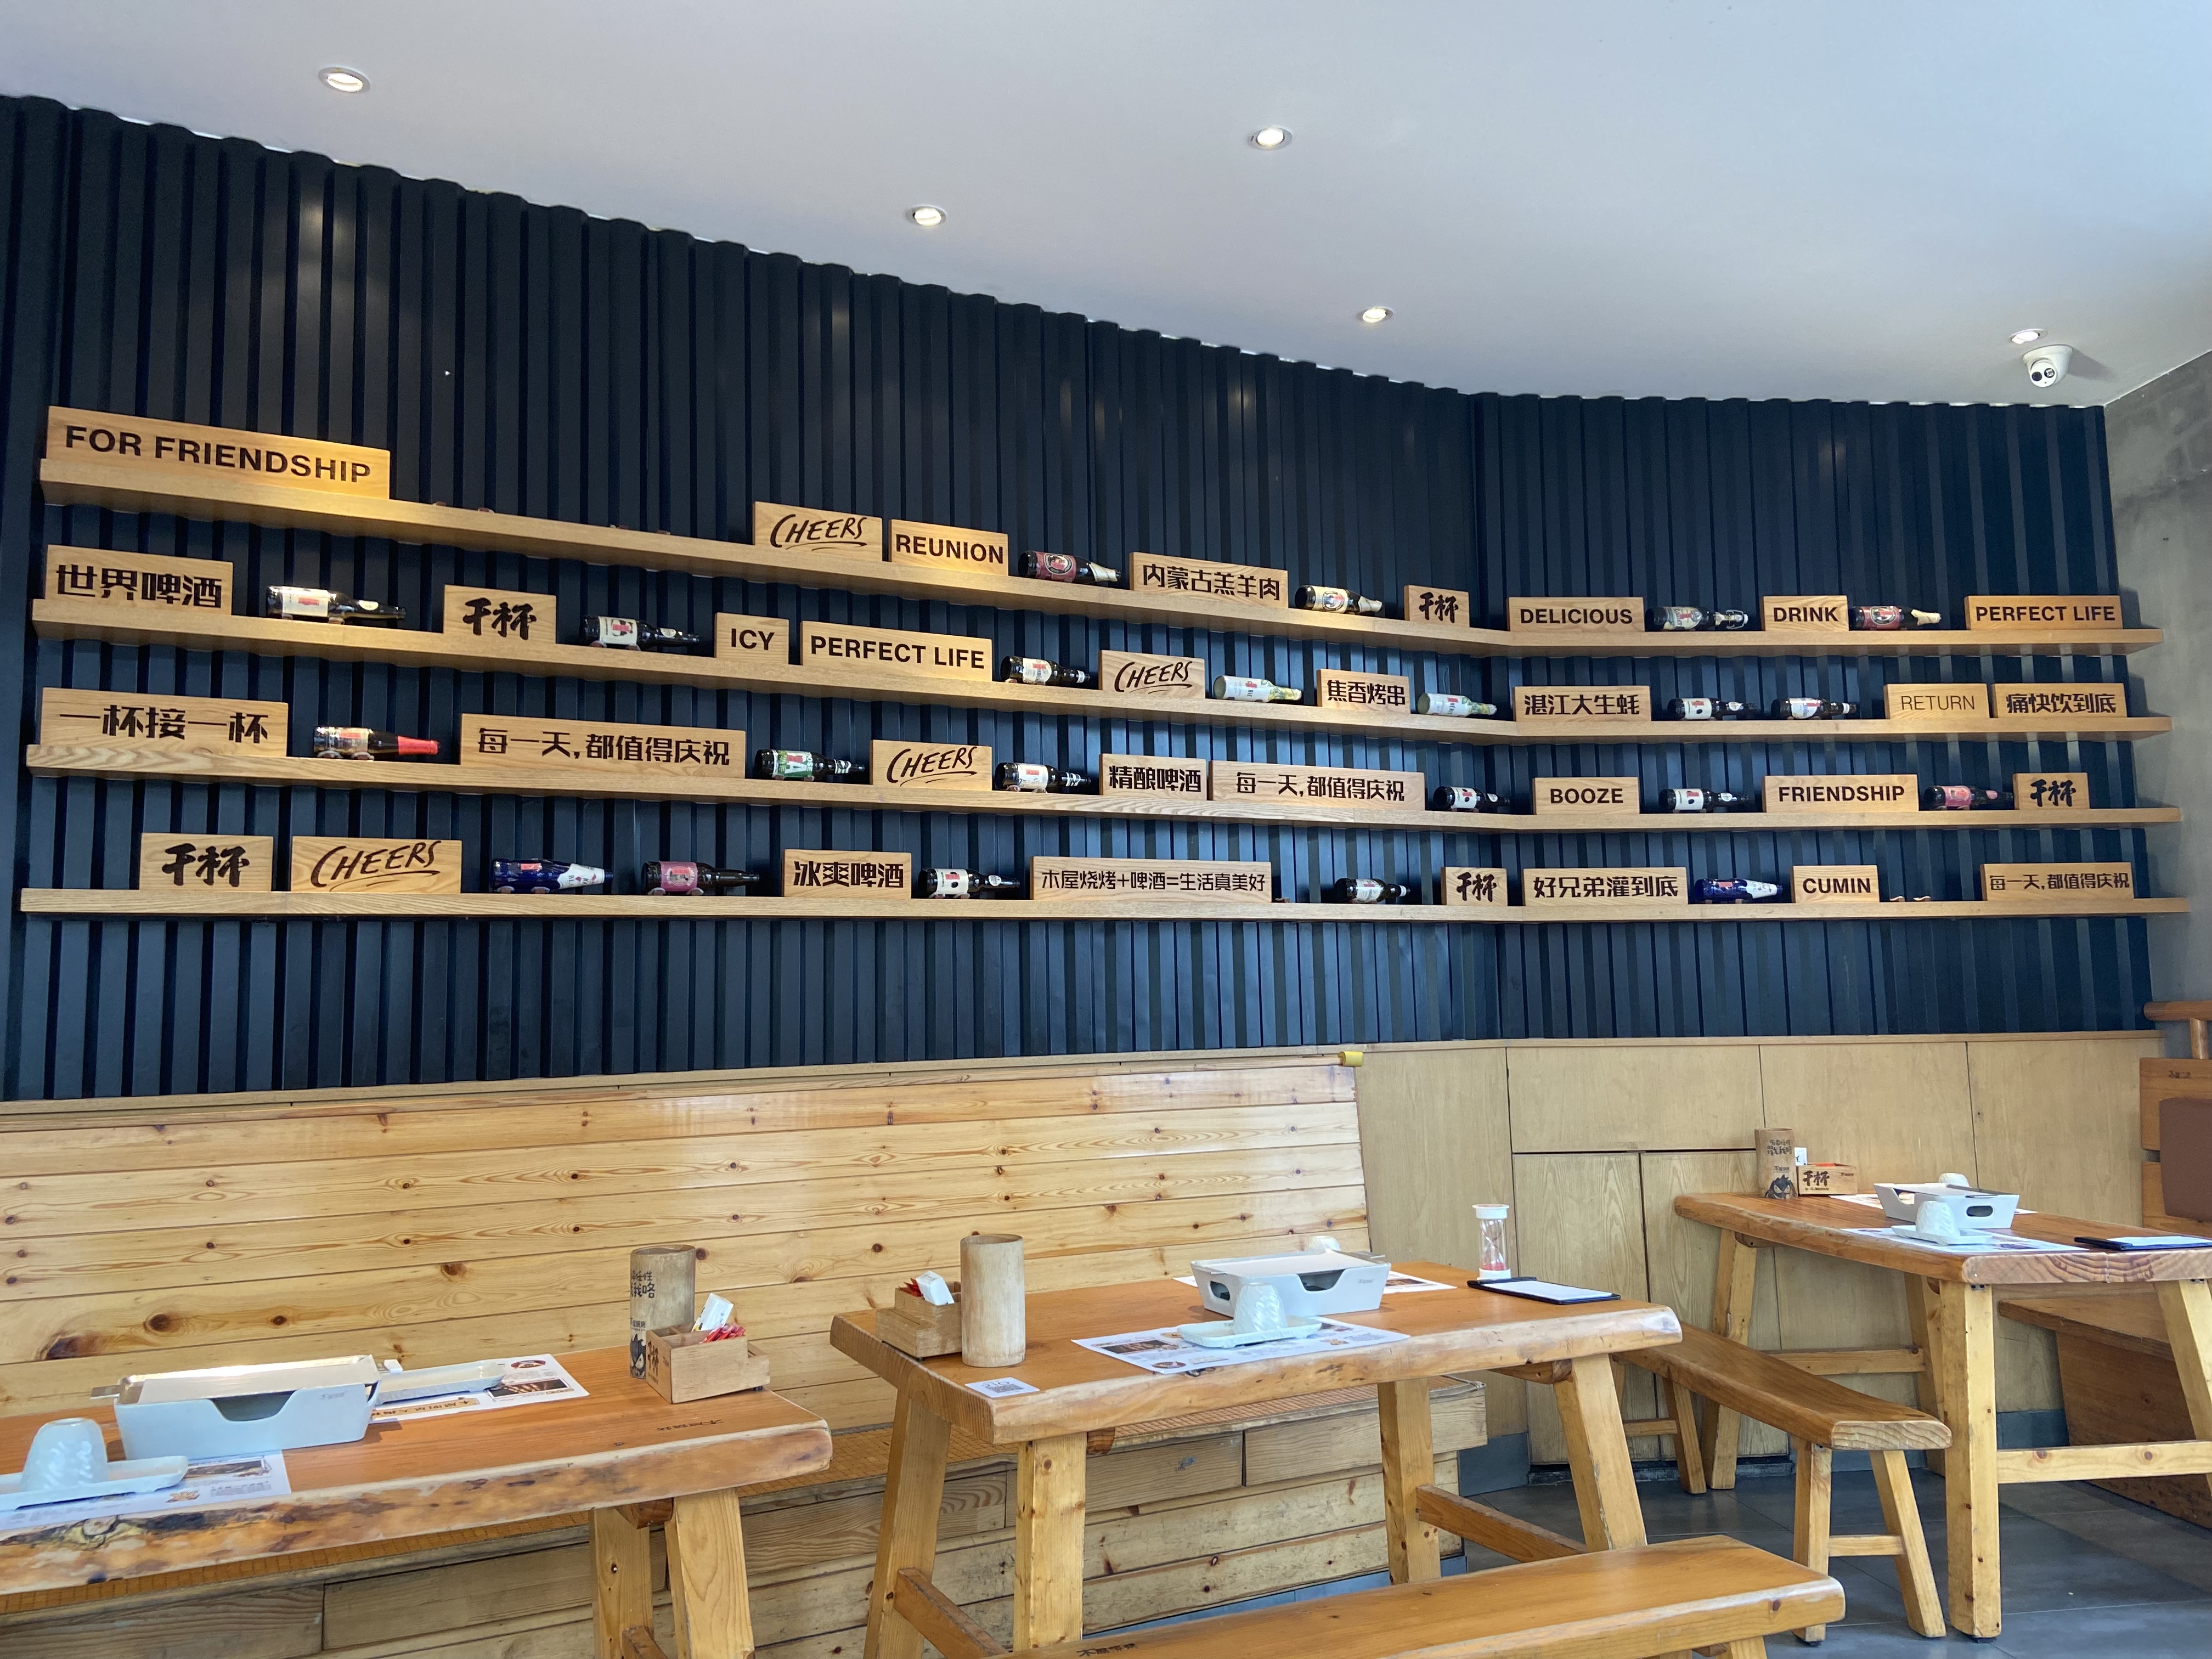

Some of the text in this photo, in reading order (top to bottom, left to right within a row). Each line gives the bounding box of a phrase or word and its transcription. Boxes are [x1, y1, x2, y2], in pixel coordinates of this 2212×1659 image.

[66, 425, 370, 483] FOR FRIENDSHIP
[770, 514, 867, 551] CHEERS
[896, 533, 1003, 564] REUNION
[55, 564, 222, 608] 世界啤酒
[1143, 563, 1280, 601] 内蒙古羔羊肉
[462, 597, 537, 641] 干杯
[1419, 591, 1459, 624] 干杯
[1520, 608, 1633, 624] DELICIOUS
[1773, 607, 1839, 622] DRINK
[1976, 606, 2115, 622] PERFECT LIFE
[731, 628, 775, 651] ICY
[811, 635, 984, 669] PERFECT LIFE
[1114, 661, 1193, 695] CHEERS
[1327, 679, 1406, 707] 焦香烤串
[1524, 694, 1640, 715] 湛江大生蚝
[1901, 695, 1975, 710] RETURN
[2006, 693, 2117, 714] 痛快饮到底
[59, 704, 269, 744] 一杯接一杯
[886, 746, 978, 787] CHEERS
[1109, 765, 1201, 793] 精酿啤酒
[1550, 788, 1623, 804] BOOZE
[1779, 786, 1904, 802] FRIENDSHIP
[2030, 779, 2076, 808] 干杯
[161, 843, 250, 888] 干杯
[310, 840, 442, 890] CHEERS
[793, 860, 904, 888] 冰爽啤酒
[1041, 870, 1265, 891] 木屋烧烤+啤酒=生活真美好
[1456, 872, 1497, 902] 干杯
[1533, 876, 1678, 898] 好兄弟灌到底
[1802, 878, 1871, 894] CUMIN
